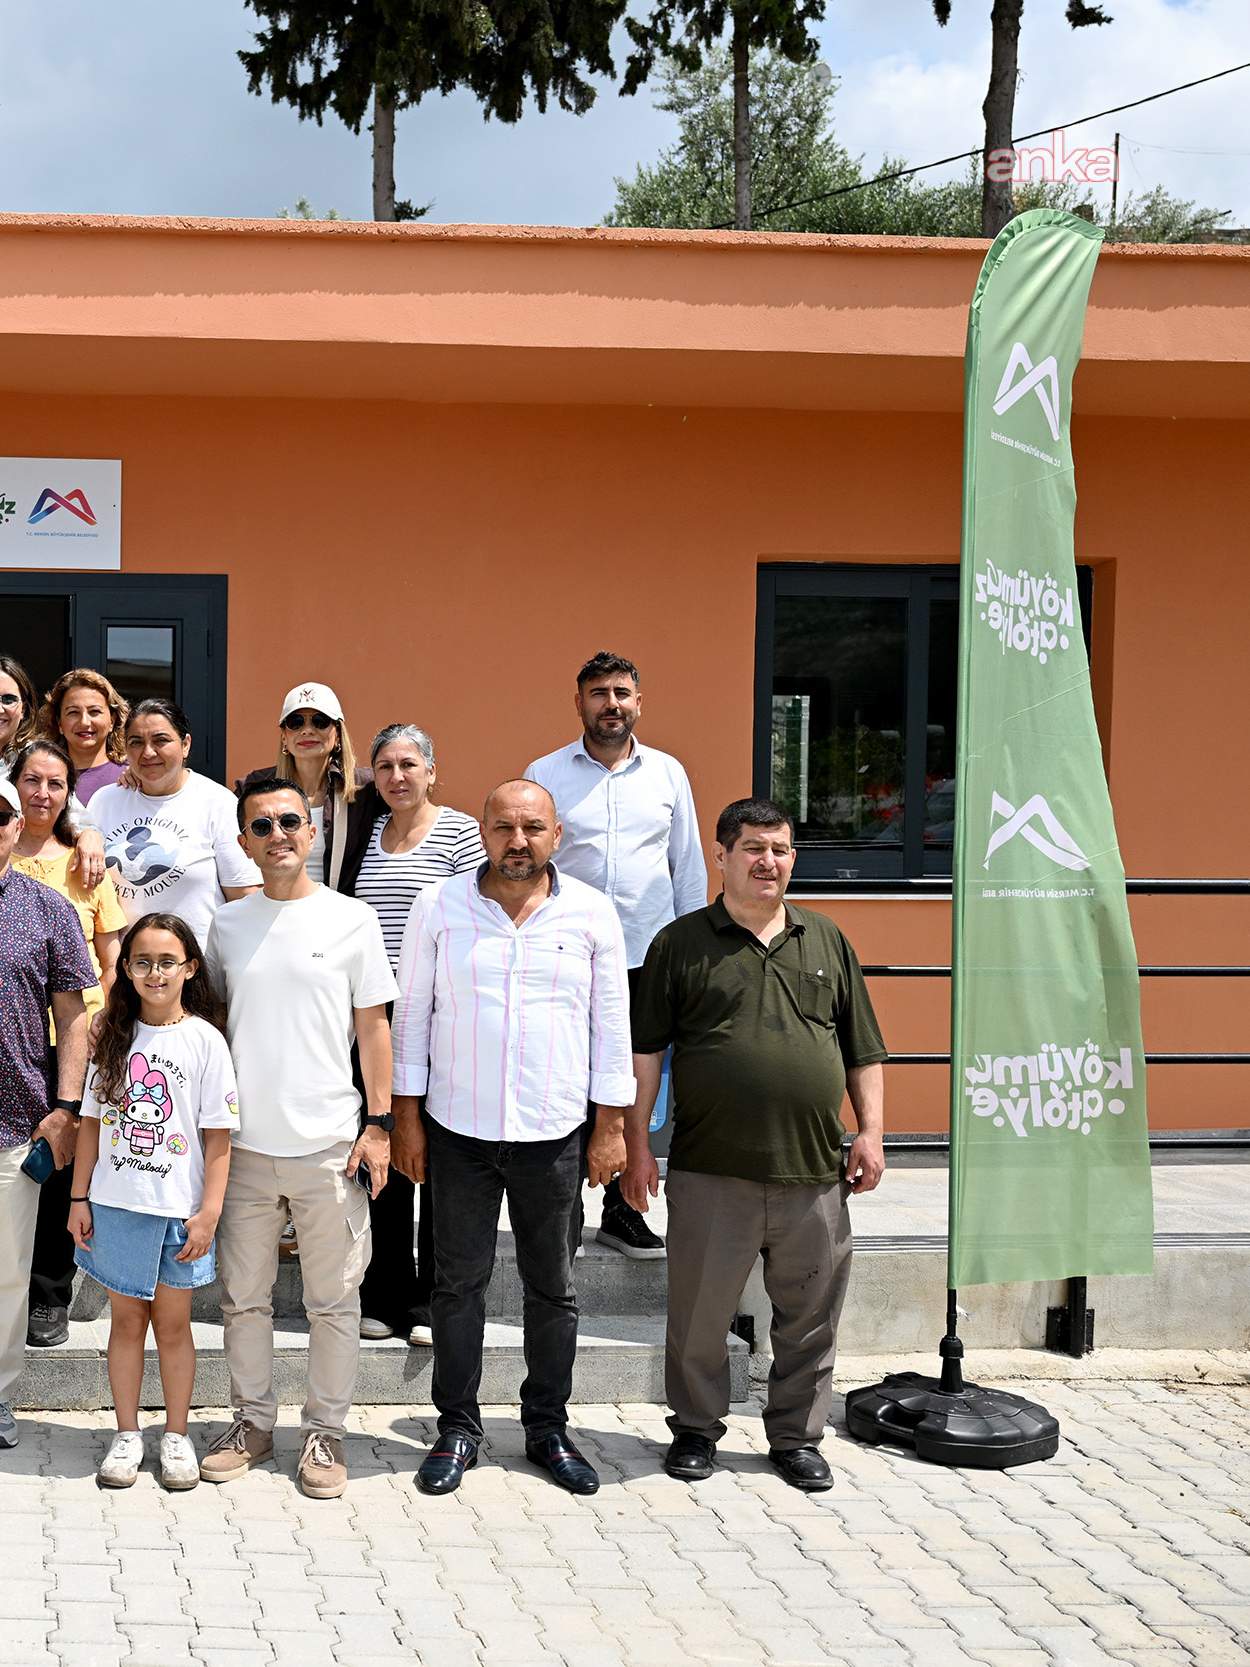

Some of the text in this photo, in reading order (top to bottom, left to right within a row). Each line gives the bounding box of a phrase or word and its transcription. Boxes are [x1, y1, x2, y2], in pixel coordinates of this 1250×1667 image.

[105, 816, 190, 843] THE ORIGINAL
[143, 865, 186, 899] MOUSE
[110, 1154, 172, 1179] My Melody
